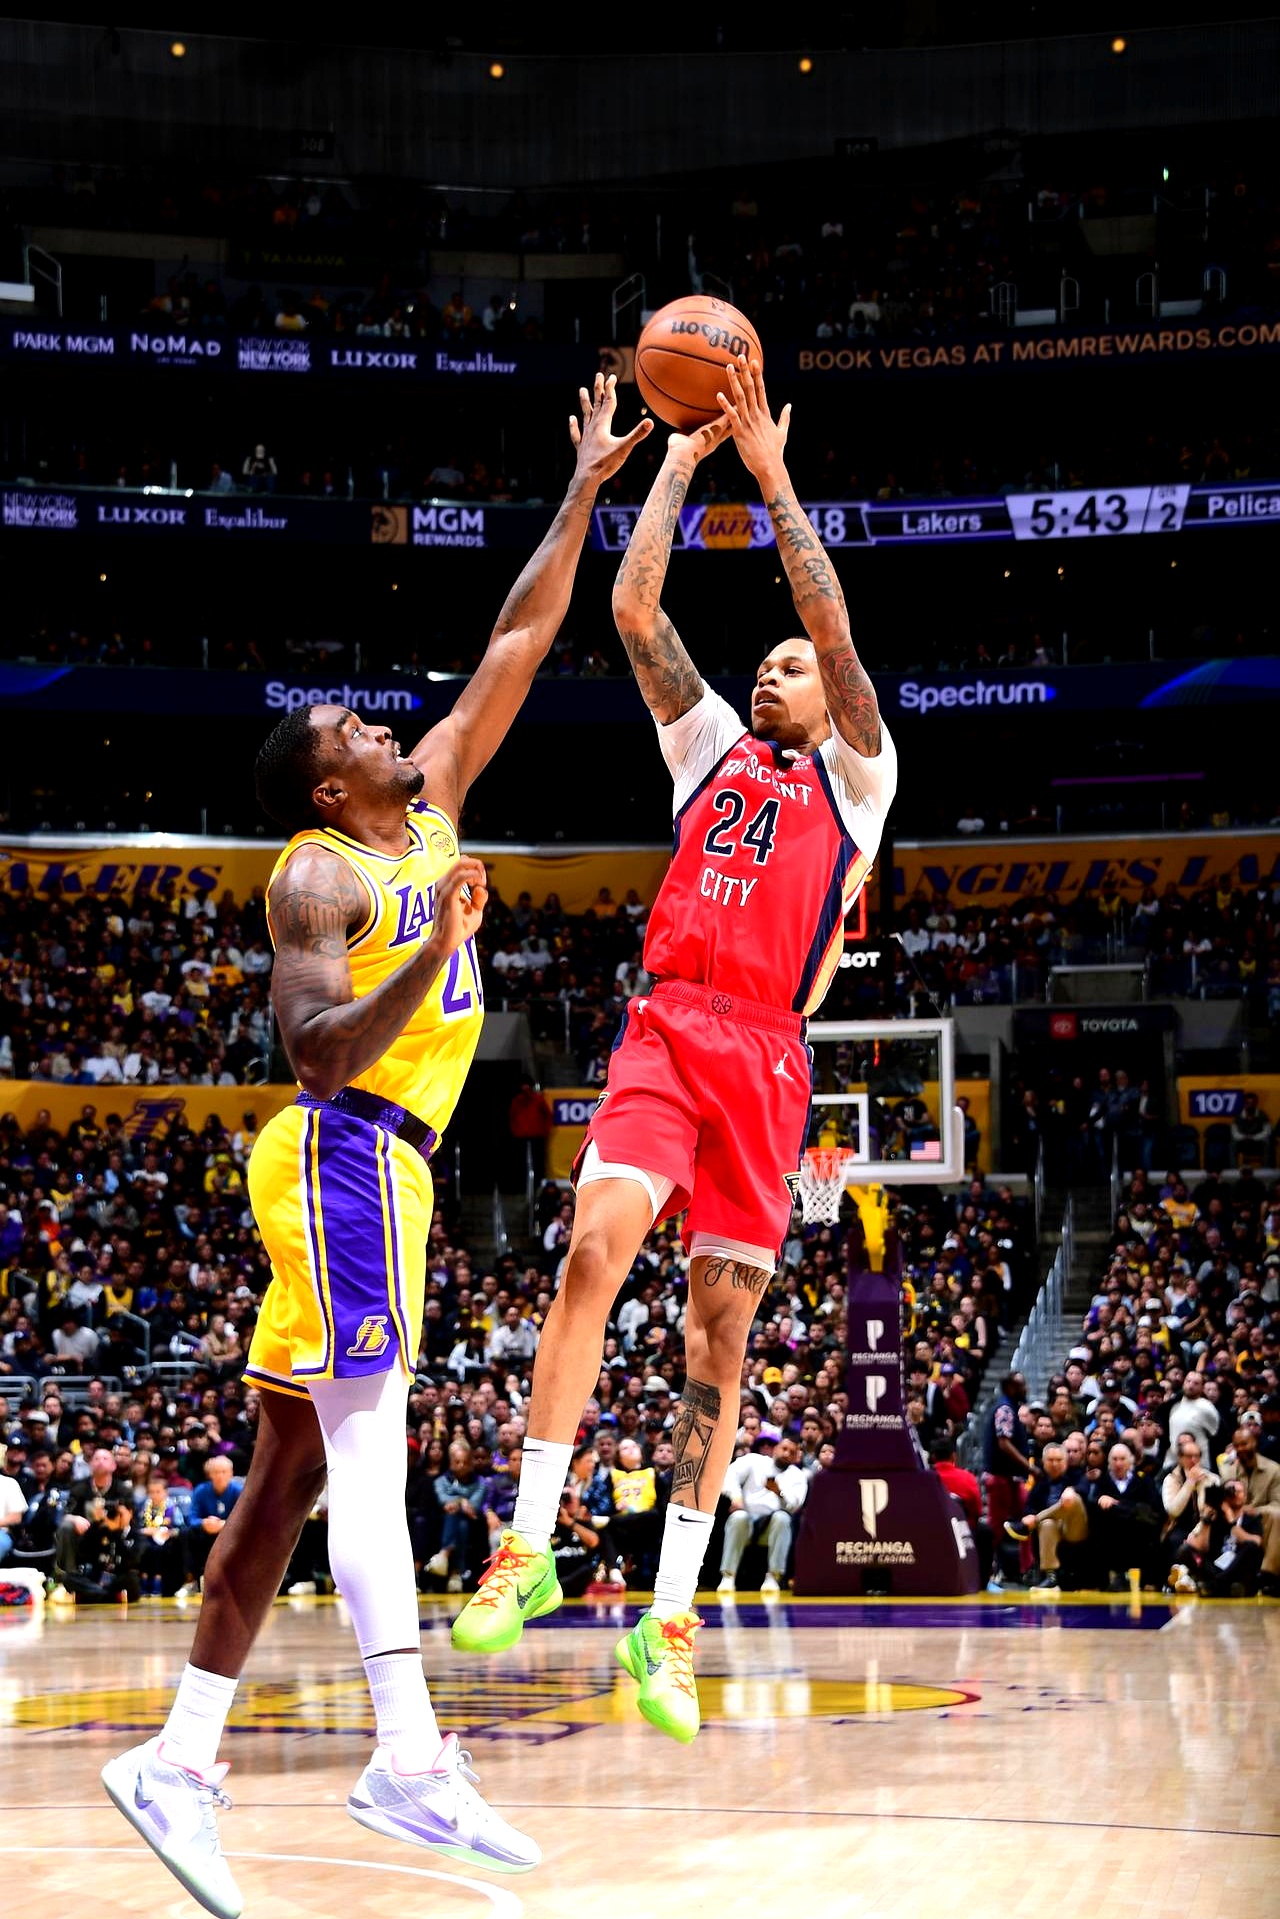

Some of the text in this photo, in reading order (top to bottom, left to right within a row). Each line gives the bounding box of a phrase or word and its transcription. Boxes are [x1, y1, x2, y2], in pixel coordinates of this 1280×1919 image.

[12, 330, 115, 355] PARK MGM
[670, 319, 750, 363] Wilson
[799, 321, 1280, 371] BOOK VEGAS AT MGMREWARDS.COM
[272, 353, 311, 367] YORK
[330, 349, 418, 370] LUXOR
[435, 351, 518, 375] Excalibur
[97, 505, 187, 525] LUXOR
[204, 507, 288, 530] Excalibur
[412, 506, 484, 532] MGM
[902, 512, 982, 535] Lakers
[1030, 494, 1128, 538] 5:43
[1160, 502, 1177, 530] 2
[265, 681, 412, 714] Spectrum
[899, 680, 1046, 714] Spectrum
[704, 787, 782, 866] 24
[700, 867, 758, 907] CITY
[441, 934, 484, 1015] 2
[1080, 1018, 1138, 1033] TOYOTA
[1195, 1092, 1238, 1114] 107
[846, 1414, 903, 1423] PECHANGA
[835, 1541, 914, 1555] PECHANGA
